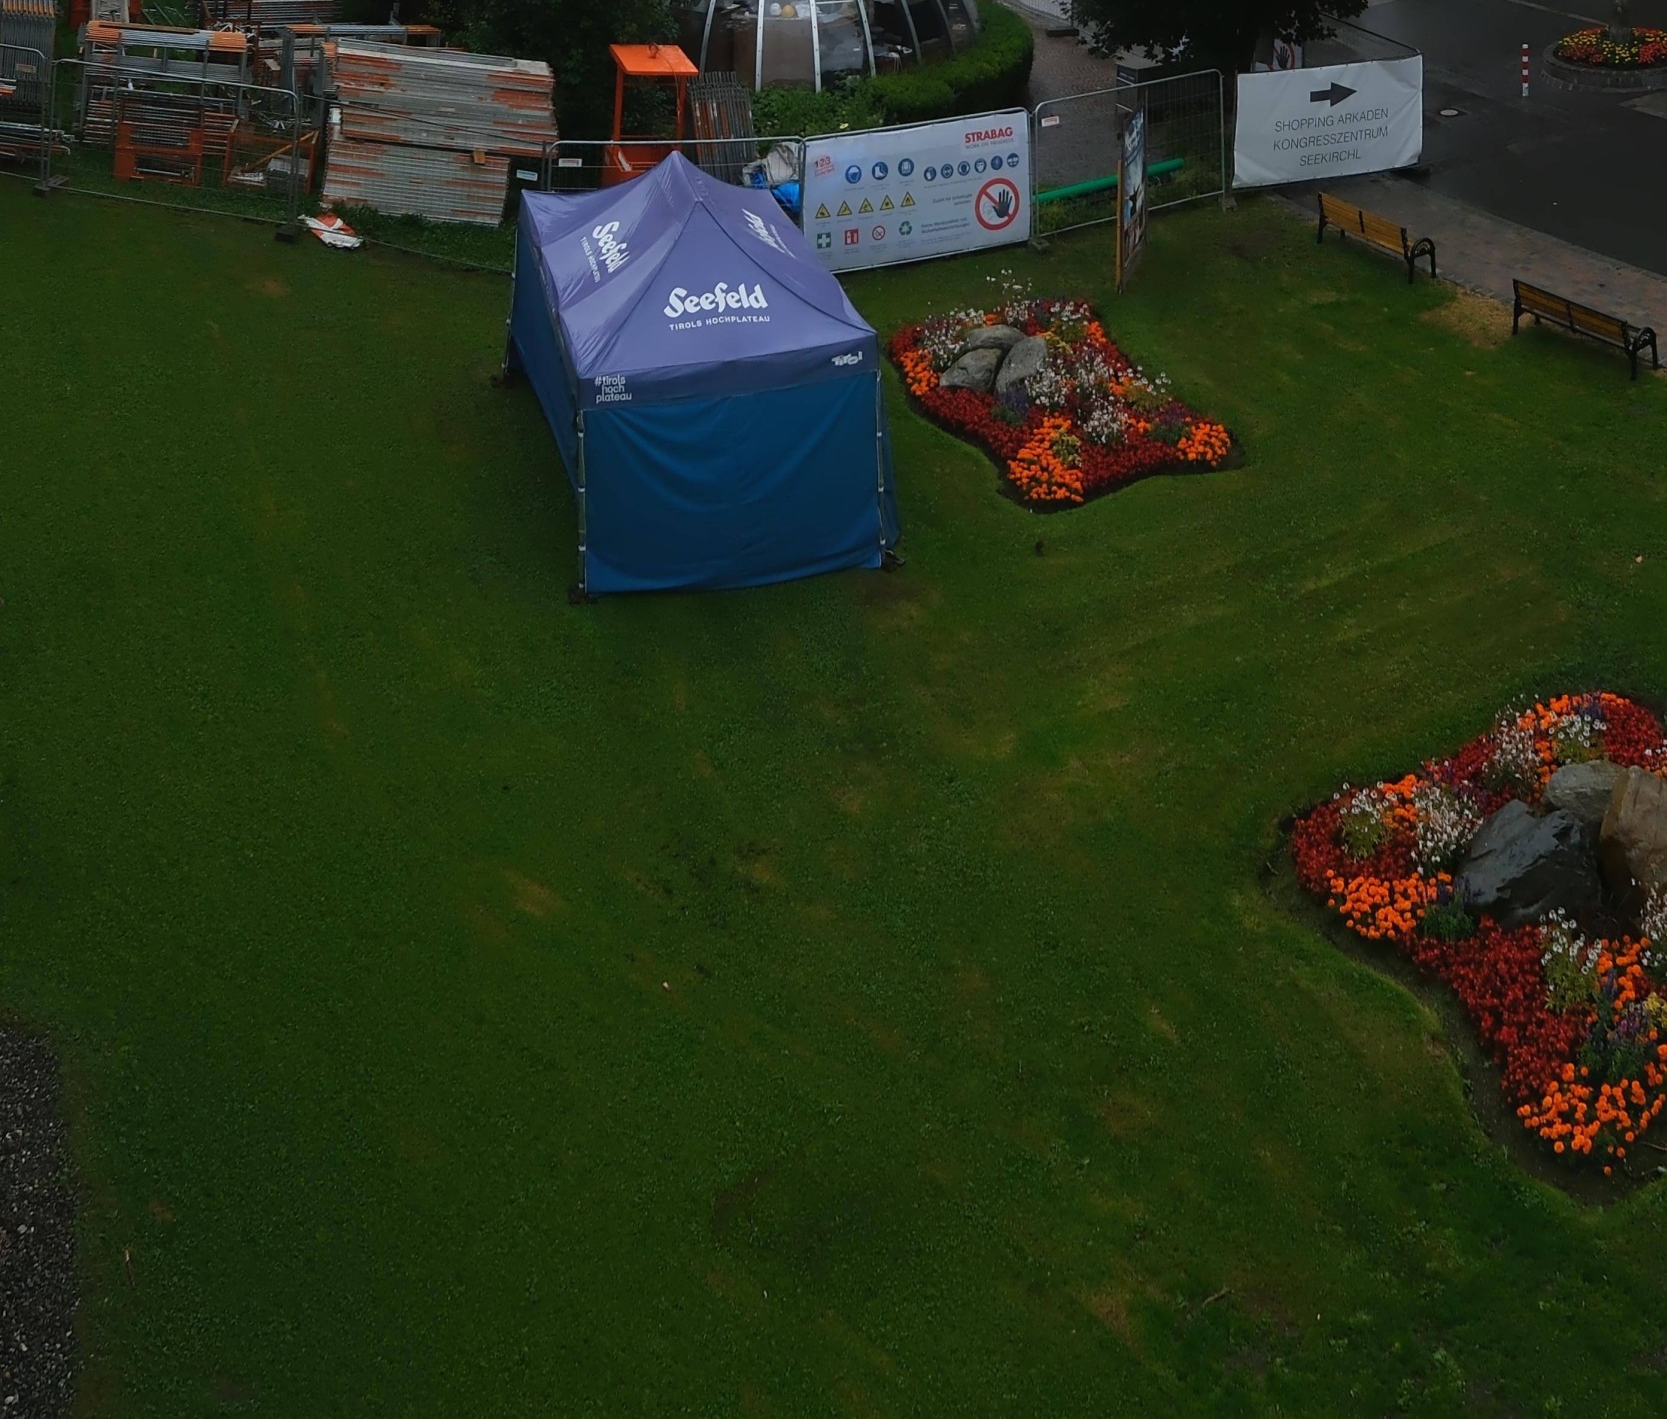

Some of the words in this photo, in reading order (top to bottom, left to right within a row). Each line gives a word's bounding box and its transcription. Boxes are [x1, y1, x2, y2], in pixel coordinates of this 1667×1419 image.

[1274, 115, 1334, 132] SHOPPING
[1337, 107, 1389, 124] ARKADEN
[964, 126, 1014, 144] STRABAG
[1273, 126, 1388, 151] KONGRESSZENTRUM
[1299, 149, 1361, 167] SEEKIRCHL
[663, 282, 769, 319] Seefeld
[669, 319, 703, 331] TIROLS
[705, 315, 770, 327] HOCHPLATEAU
[596, 392, 632, 405] plateau
